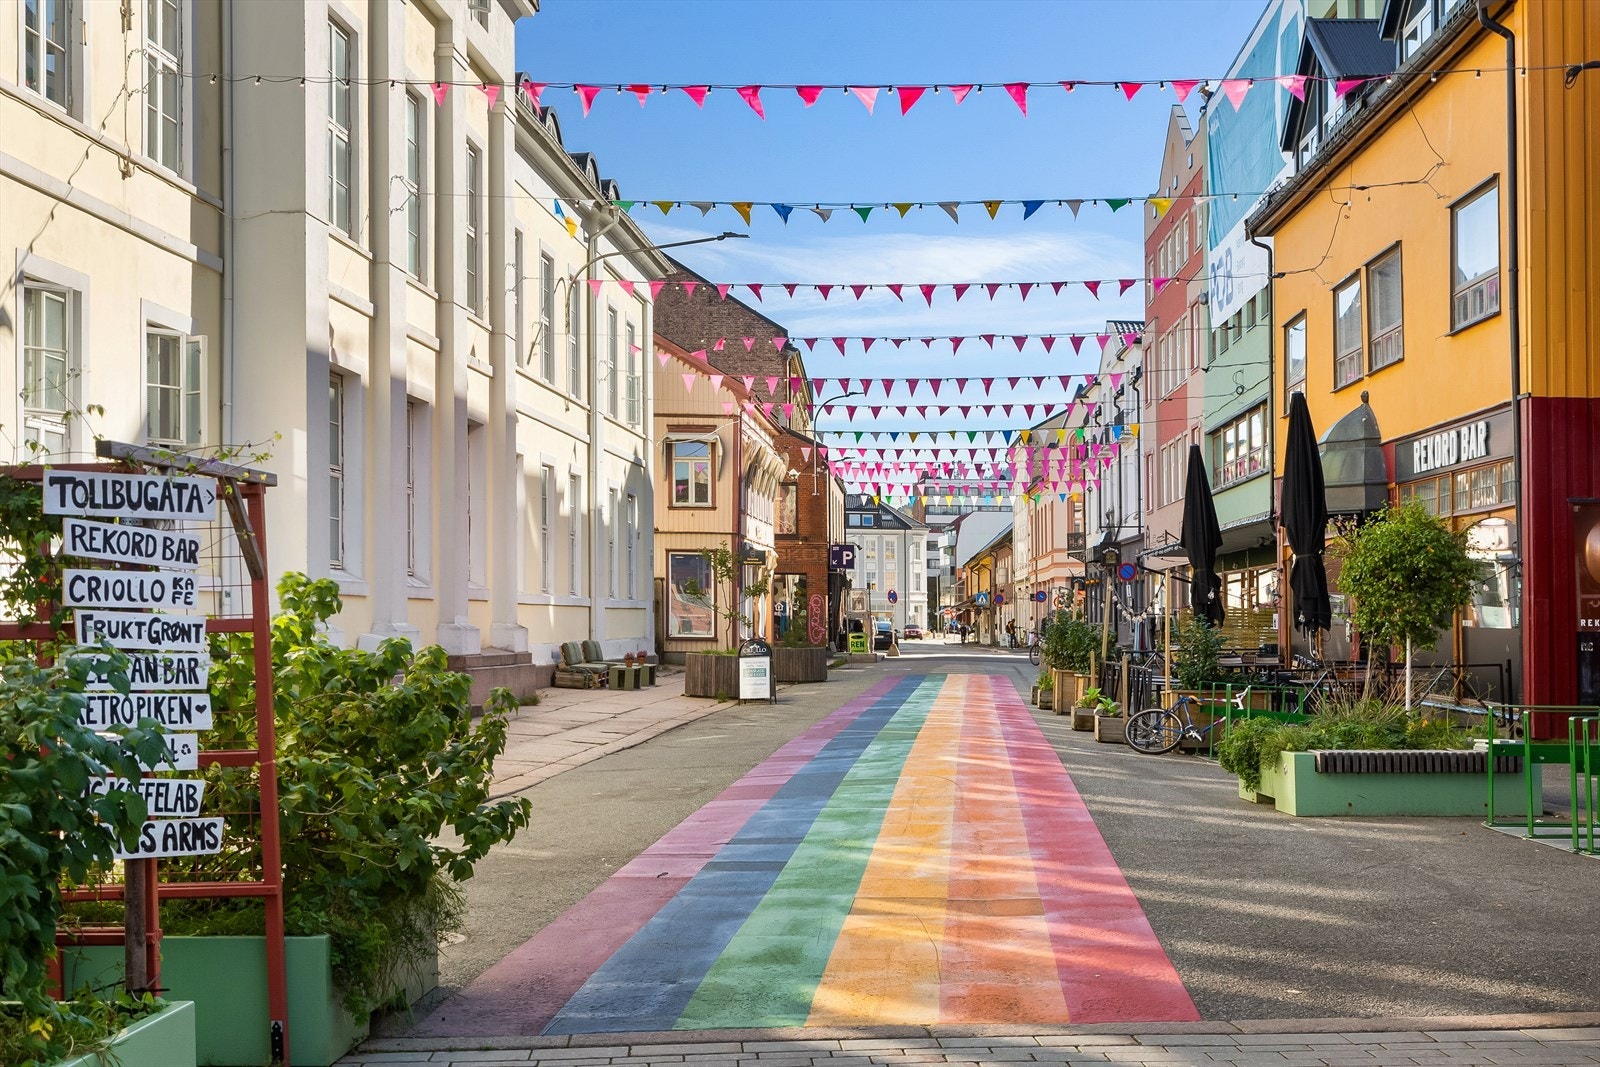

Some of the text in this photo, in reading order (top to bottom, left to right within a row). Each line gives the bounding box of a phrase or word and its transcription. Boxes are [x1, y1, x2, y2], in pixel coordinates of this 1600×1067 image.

[1413, 420, 1487, 474] REKORD BAR
[49, 476, 205, 513] TOLLBUGATA
[71, 524, 199, 564] REKORD BAR
[842, 550, 853, 565] P
[69, 574, 165, 603] CRIOLLO
[163, 657, 199, 684] BAR
[162, 821, 219, 852] ARMS
